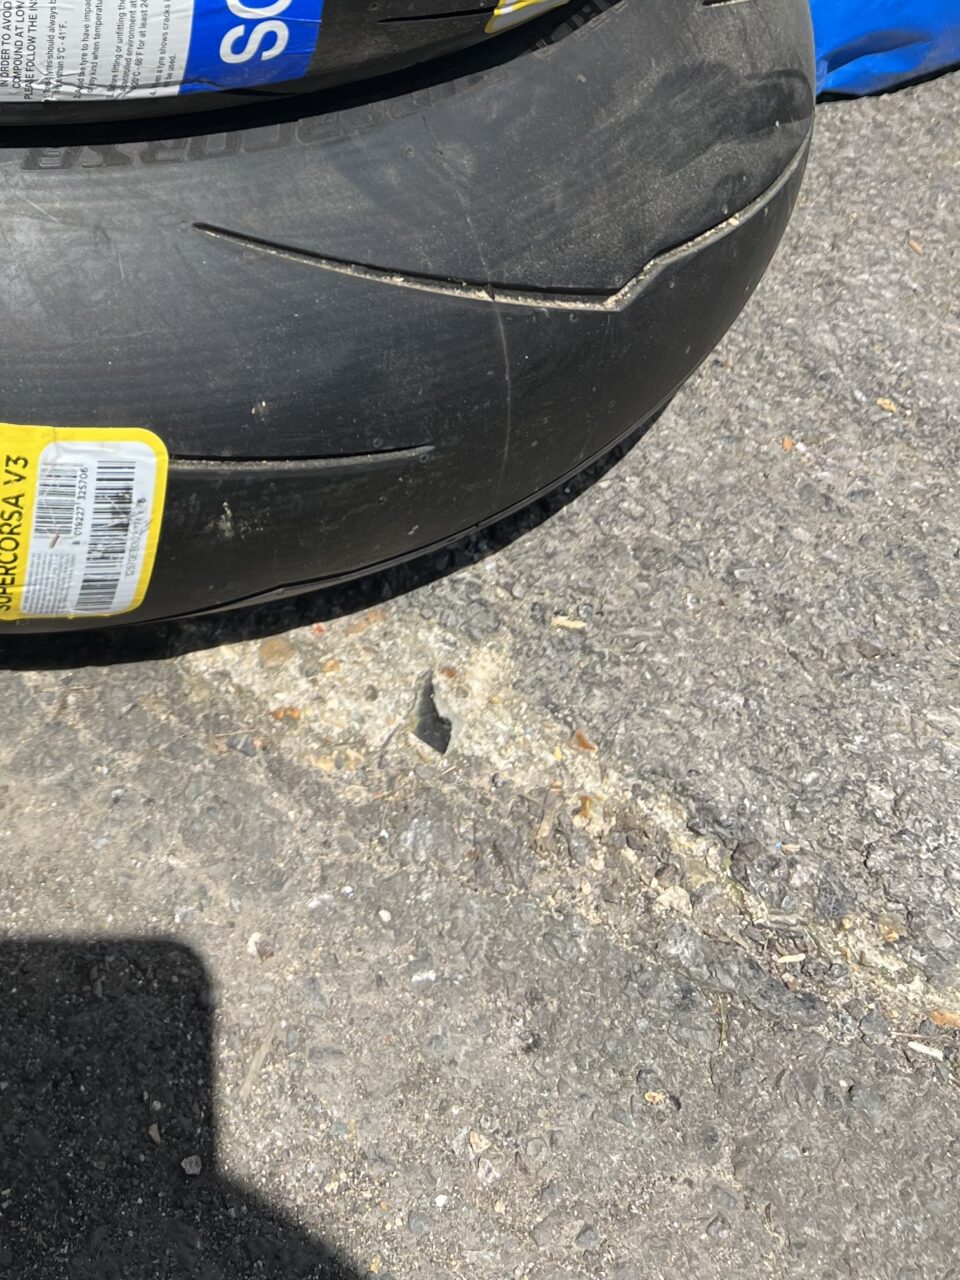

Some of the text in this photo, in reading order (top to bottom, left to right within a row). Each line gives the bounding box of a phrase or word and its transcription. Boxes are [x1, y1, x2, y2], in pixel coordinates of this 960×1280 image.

[16, 1, 25, 22] LOW
[130, 0, 137, 8] at
[2, 2, 12, 31] AVOD
[28, 14, 37, 32] THE
[48, 6, 57, 33] always
[116, 12, 126, 43] unfitting
[140, 10, 148, 28] least
[162, 4, 170, 30] cracks
[2, 34, 10, 46] TO
[15, 25, 24, 37] AT
[82, 24, 90, 42] have
[126, 10, 136, 56] environment
[139, 30, 146, 38] at
[25, 36, 36, 72] FOLLOW
[92, 42, 100, 60] when
[159, 32, 168, 55] shows
[0, 48, 10, 77] ORDER
[12, 40, 23, 88] COMPOUND
[80, 52, 88, 66] tyre
[112, 54, 123, 73] fitting
[157, 56, 165, 68] tyre
[24, 74, 34, 100] PLEAE
[3, 455, 28, 485] V3
[76, 467, 88, 500] 325706
[74, 506, 85, 536] 019227
